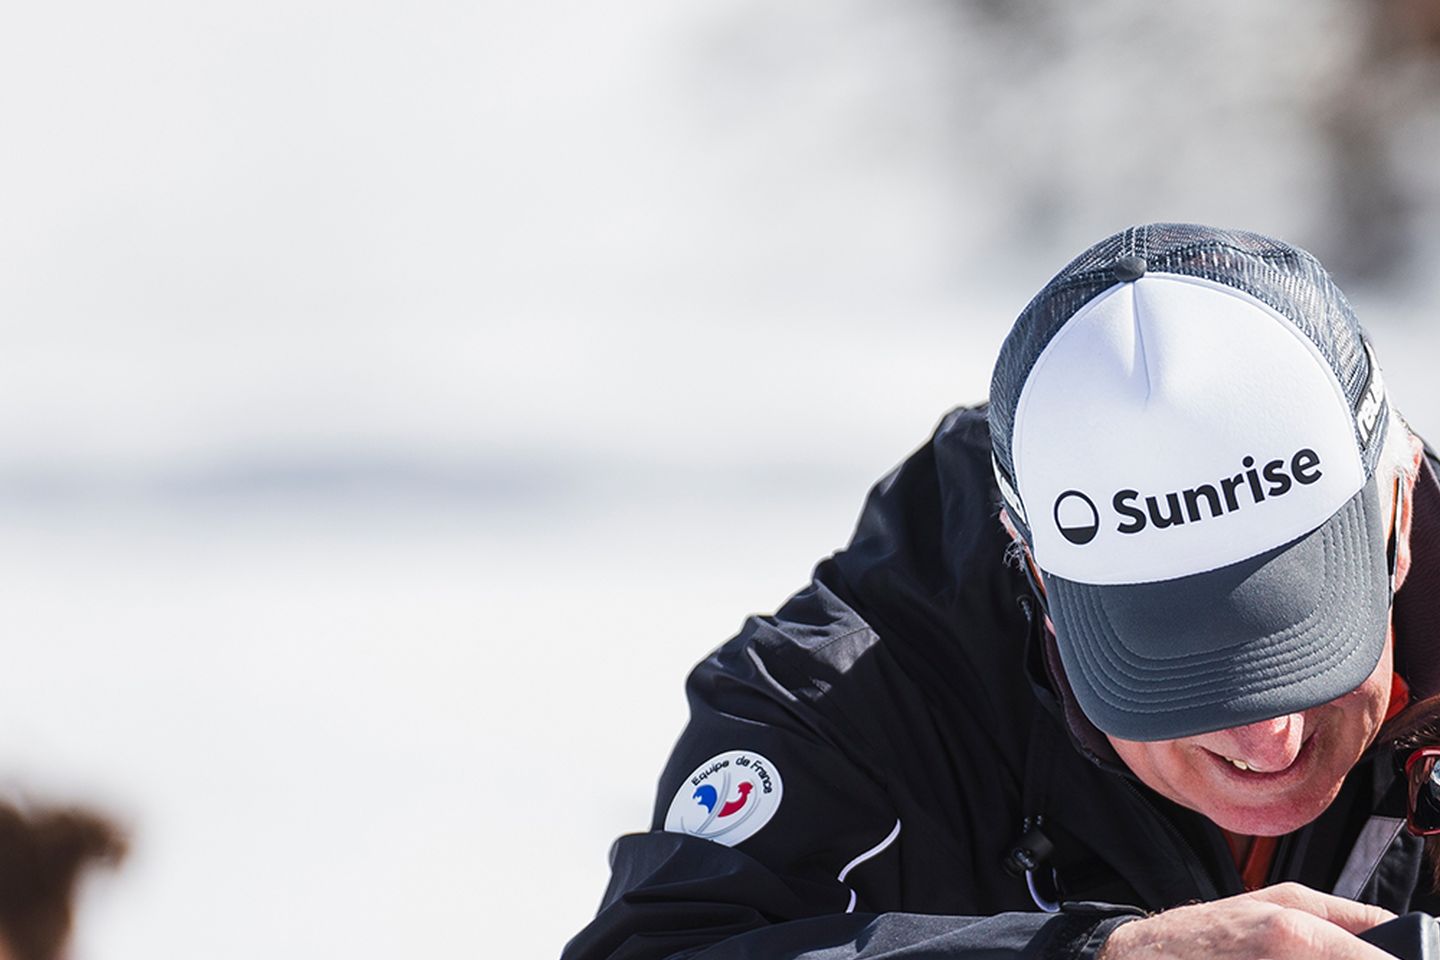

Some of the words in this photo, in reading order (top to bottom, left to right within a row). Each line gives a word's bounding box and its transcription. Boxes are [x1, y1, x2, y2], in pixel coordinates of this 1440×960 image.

[1112, 448, 1322, 534] Sunrise
[691, 759, 730, 786] Equipe
[735, 755, 751, 767] de
[750, 759, 773, 795] France
